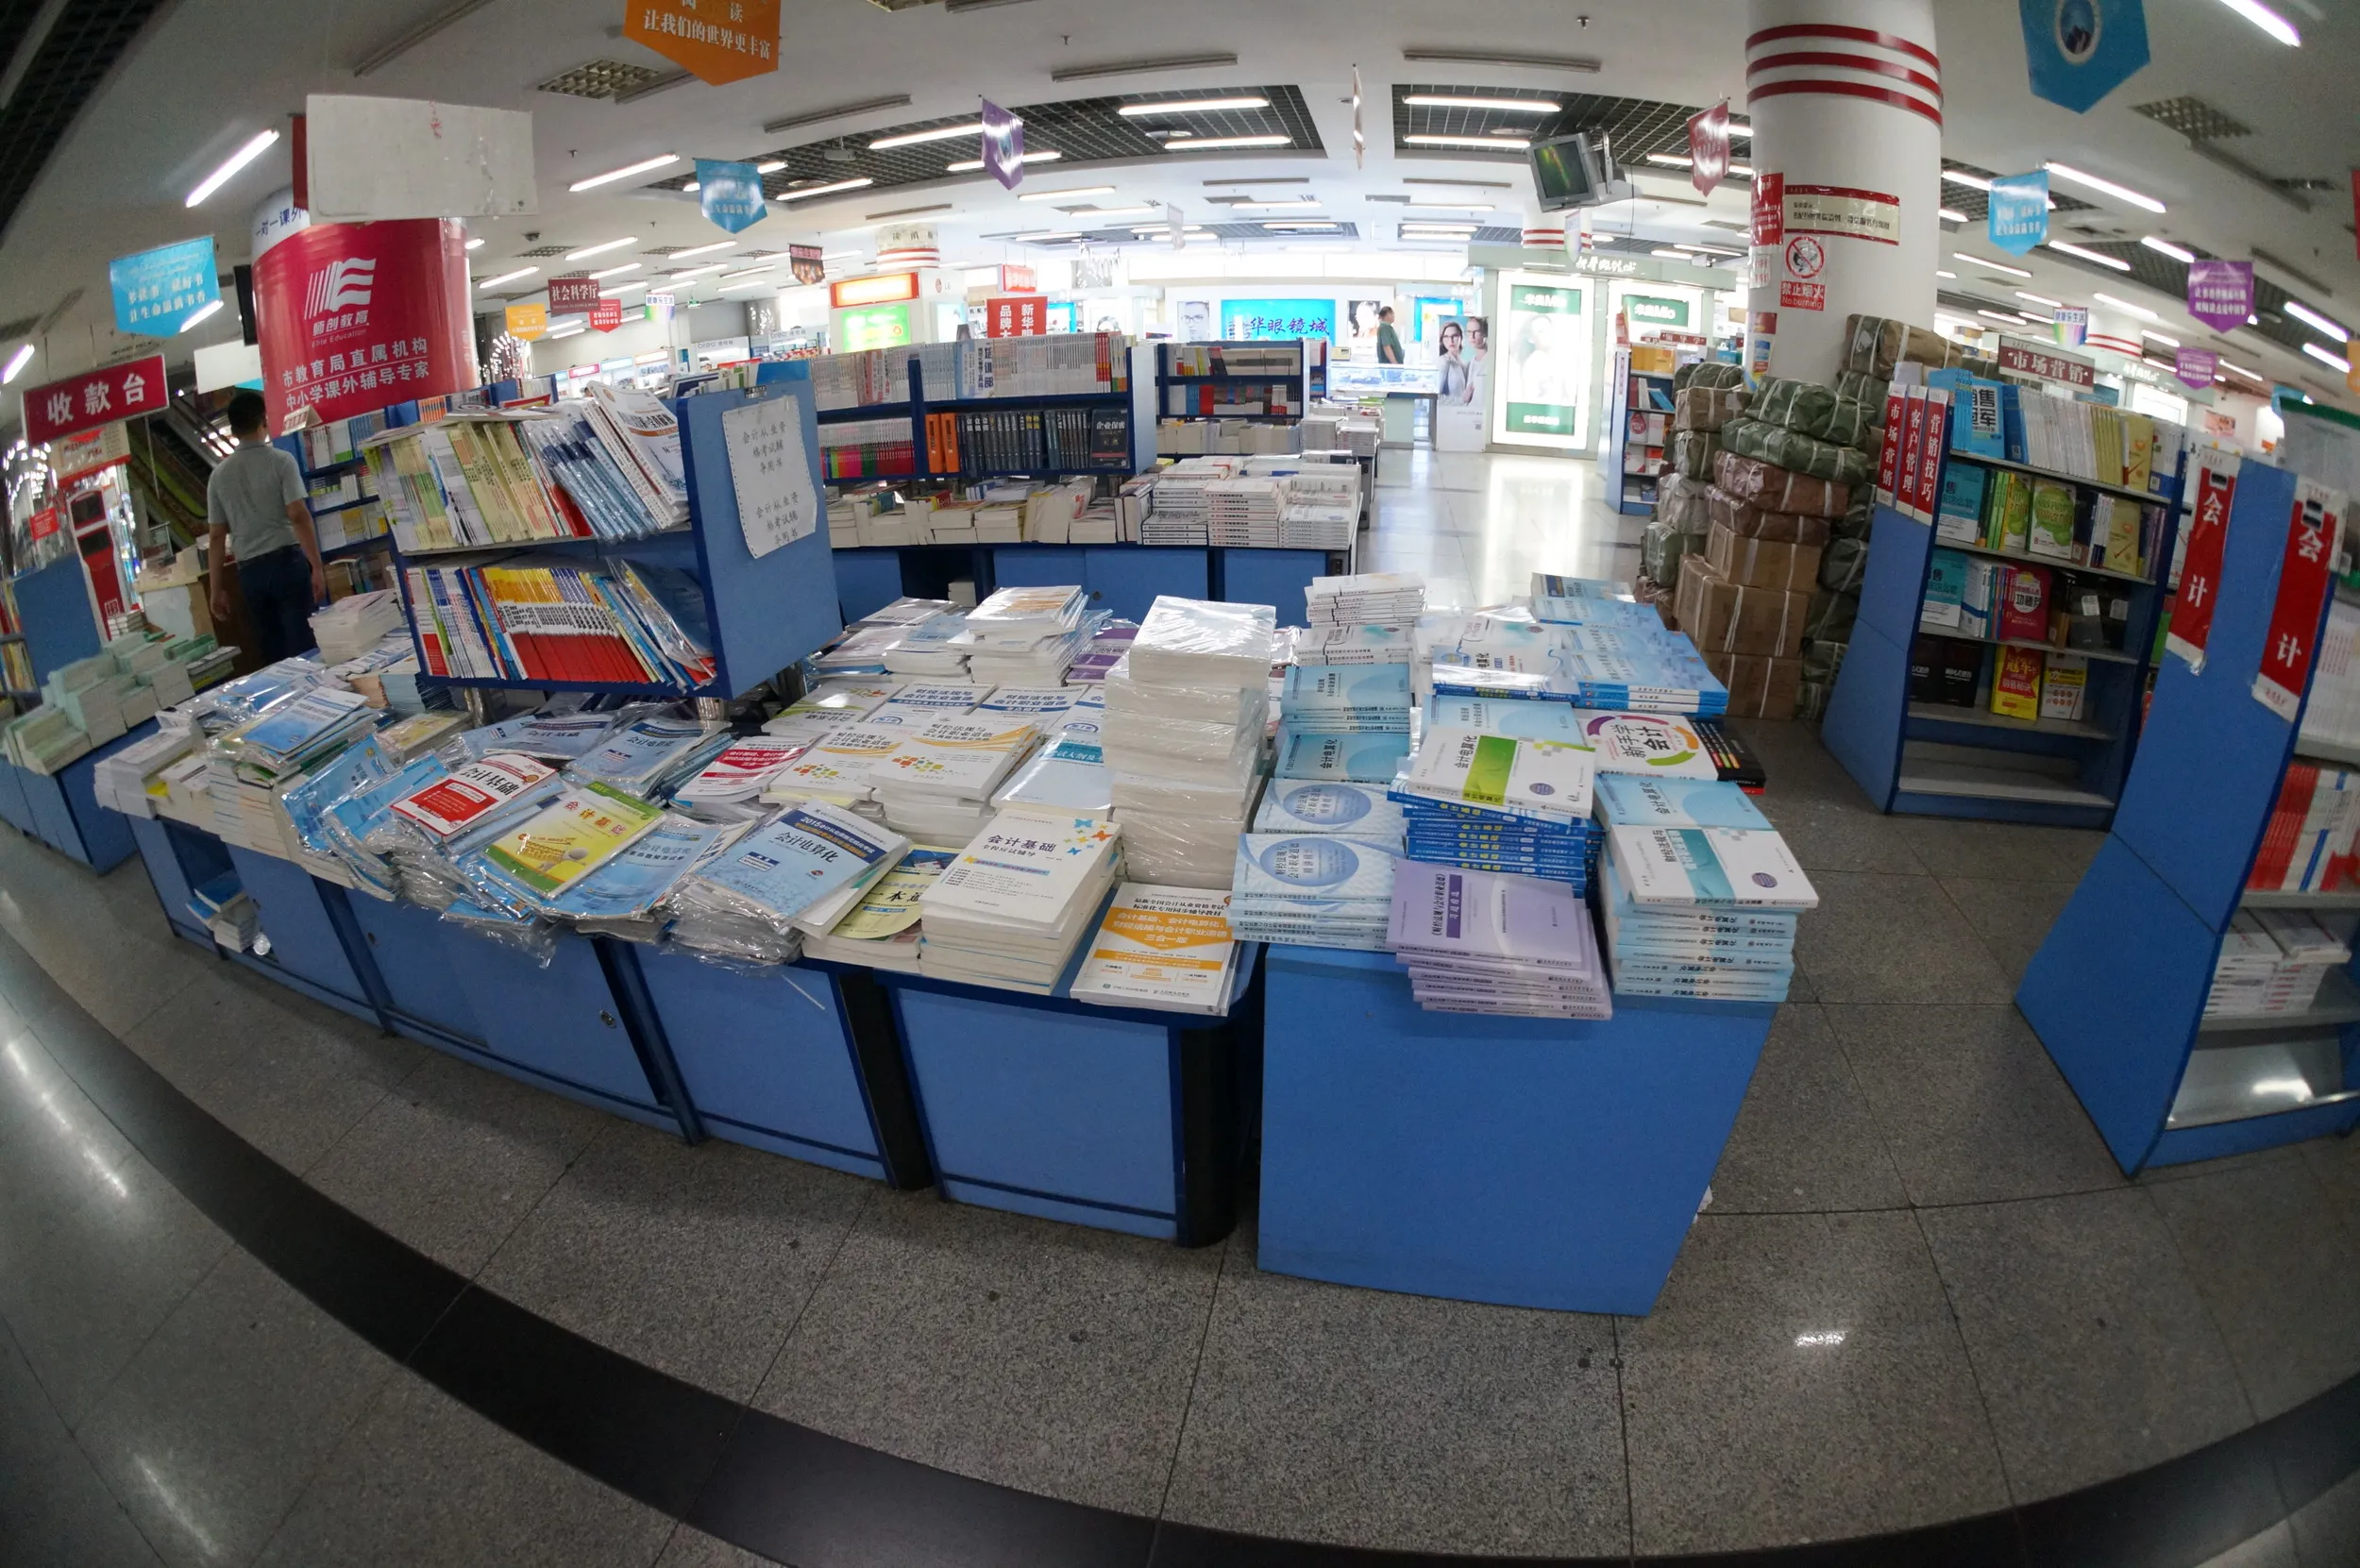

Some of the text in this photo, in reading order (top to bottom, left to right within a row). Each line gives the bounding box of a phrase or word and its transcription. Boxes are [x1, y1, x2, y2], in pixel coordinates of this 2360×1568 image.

[643, 8, 770, 60] 让我们的世界更丰富
[550, 284, 598, 302] 社会科学厅
[1781, 284, 1824, 299] 禁止烟火
[1243, 316, 1330, 337] 华眼镜城
[283, 338, 428, 388] 市教育局直属机构
[2013, 351, 2086, 384] 市场营销
[48, 373, 146, 426] 收款台
[286, 361, 430, 411] 中小学课外辅导专家
[1880, 404, 1900, 487] 市场营销
[1902, 409, 1922, 494] 客户管理
[1921, 414, 1941, 502] 营销技巧
[2186, 491, 2224, 607] 会计
[2276, 529, 2324, 667] 会计
[1320, 739, 1338, 769] 会计电算化
[1455, 734, 1477, 768] 会计电算化
[1609, 723, 1647, 758] 新手学
[1634, 726, 1671, 751] 会计
[1641, 782, 1671, 815] 会计电算化
[775, 832, 838, 863] 会计电算化
[987, 835, 1057, 852] 会计基础
